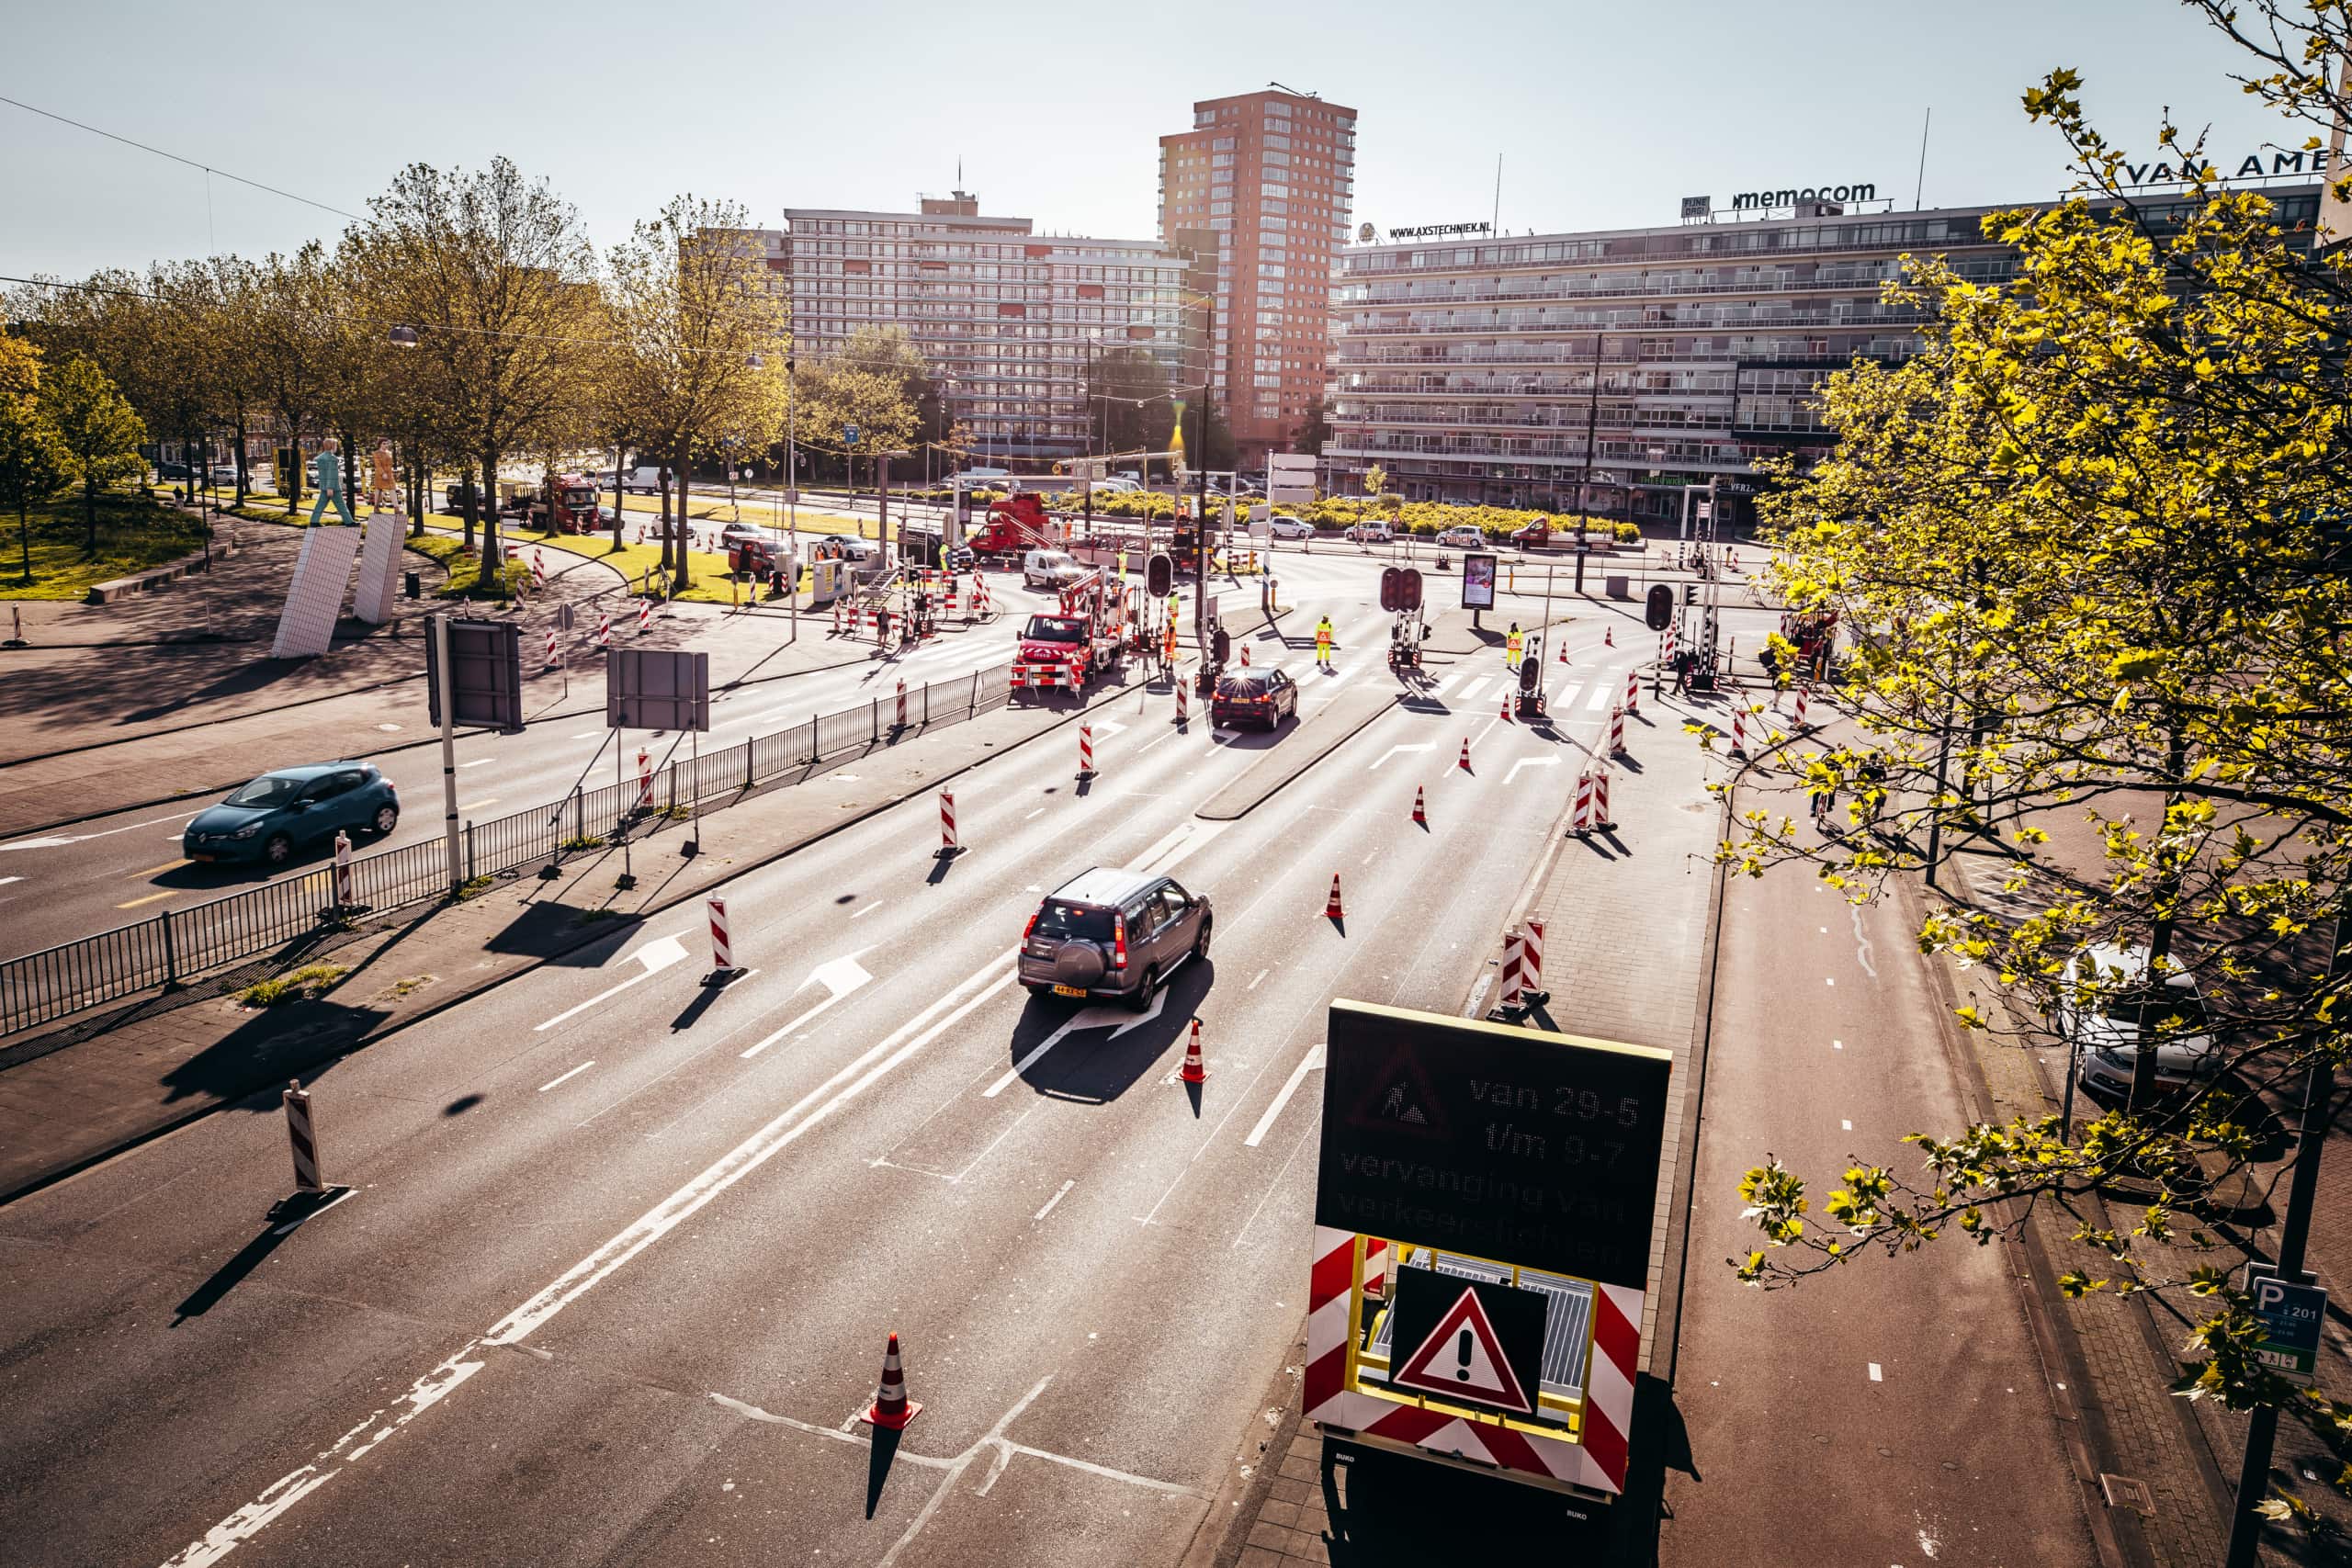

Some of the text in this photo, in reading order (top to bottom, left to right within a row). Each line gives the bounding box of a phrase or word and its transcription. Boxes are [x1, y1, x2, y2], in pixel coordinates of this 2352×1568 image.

[2126, 159, 2209, 185] VAN
[1738, 183, 1876, 209] memocom
[1389, 221, 1492, 239] WWW.AXSTECHNIEK.NL
[1470, 1079, 1639, 1131] van 29-5
[1485, 1122, 1624, 1169] t/m 9-7
[1338, 1152, 1625, 1224] vervanging van
[2258, 1284, 2285, 1311] P
[2291, 1307, 2316, 1320] 201
[1336, 1452, 1355, 1463] BUKO
[1566, 1509, 1588, 1520] BUKO
